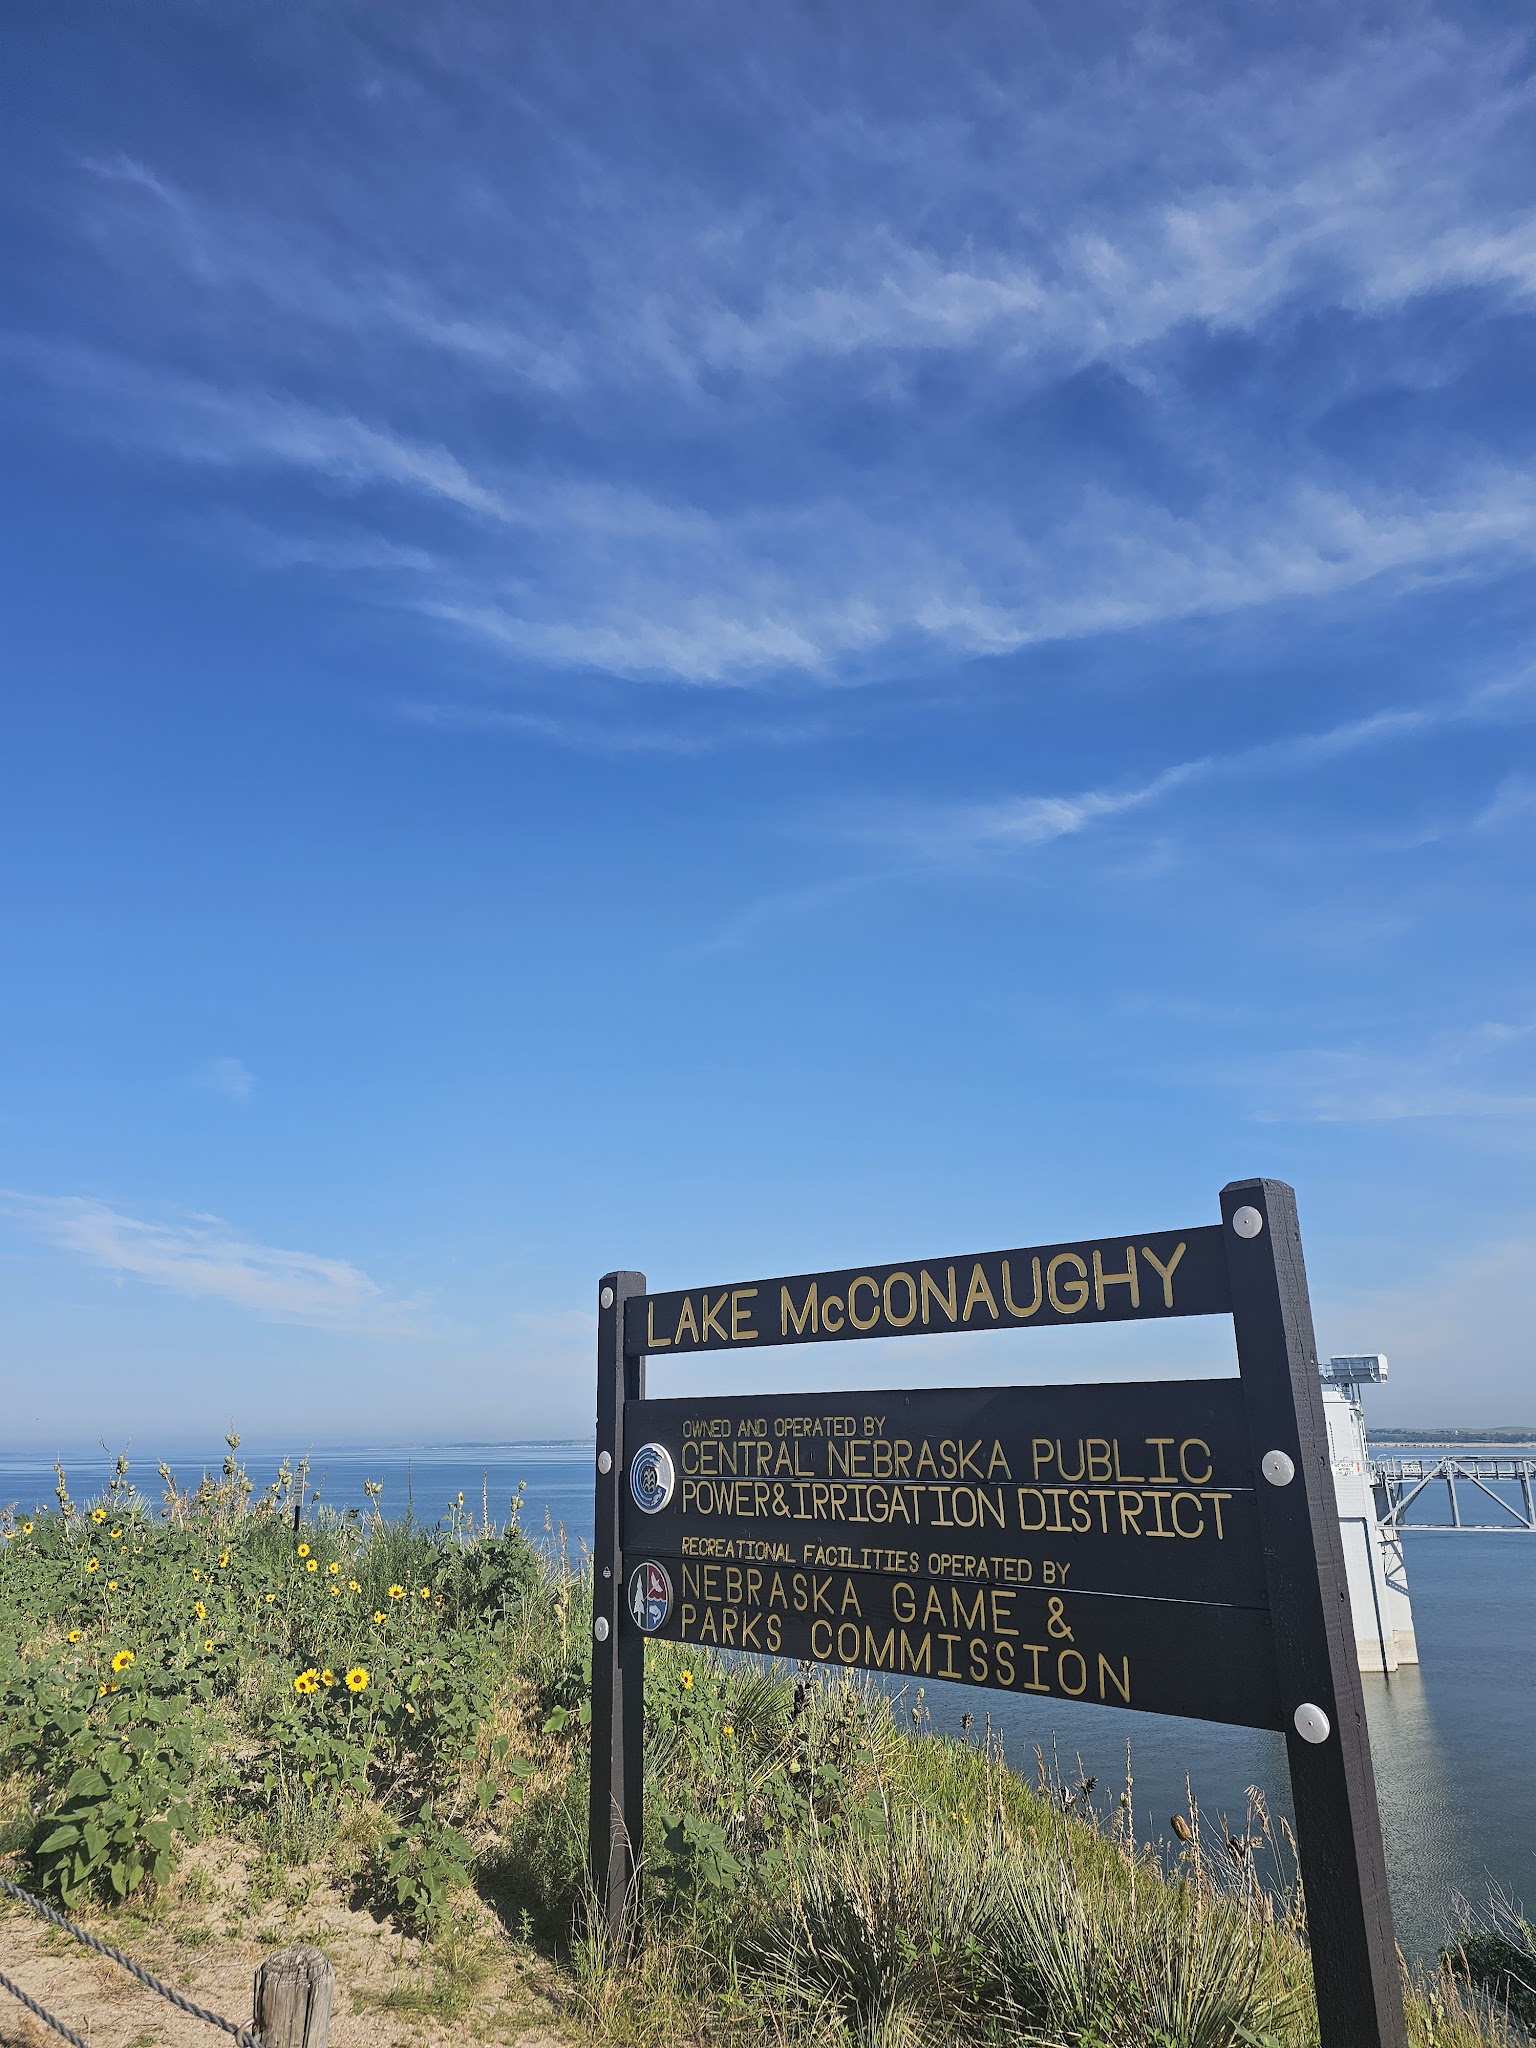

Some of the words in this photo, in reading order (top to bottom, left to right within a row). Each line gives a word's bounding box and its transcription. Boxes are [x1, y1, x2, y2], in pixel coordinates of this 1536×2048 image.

[647, 1288, 759, 1348] LAKE
[780, 1242, 1187, 1336] McCONAUGHY
[682, 1419, 732, 1439] OWNED
[737, 1418, 768, 1438] AND
[774, 1416, 857, 1438] OPERATED
[863, 1415, 886, 1437] BY
[681, 1440, 815, 1477] CENTRAL
[827, 1438, 1012, 1481] NEBRASKA
[1031, 1437, 1213, 1484] PUBLIC
[1017, 1487, 1233, 1540] DISTRICT
[681, 1536, 797, 1564] RECREATIONAL
[803, 1543, 919, 1574] FACILITIES
[928, 1552, 1034, 1583] OPERATED
[1042, 1560, 1071, 1586] BY
[681, 1562, 862, 1618] NEBRASKA
[893, 1581, 1020, 1637] GAME
[1047, 1596, 1075, 1641] &
[681, 1603, 782, 1653] PARKS
[810, 1619, 1131, 1703] COMMISSION
